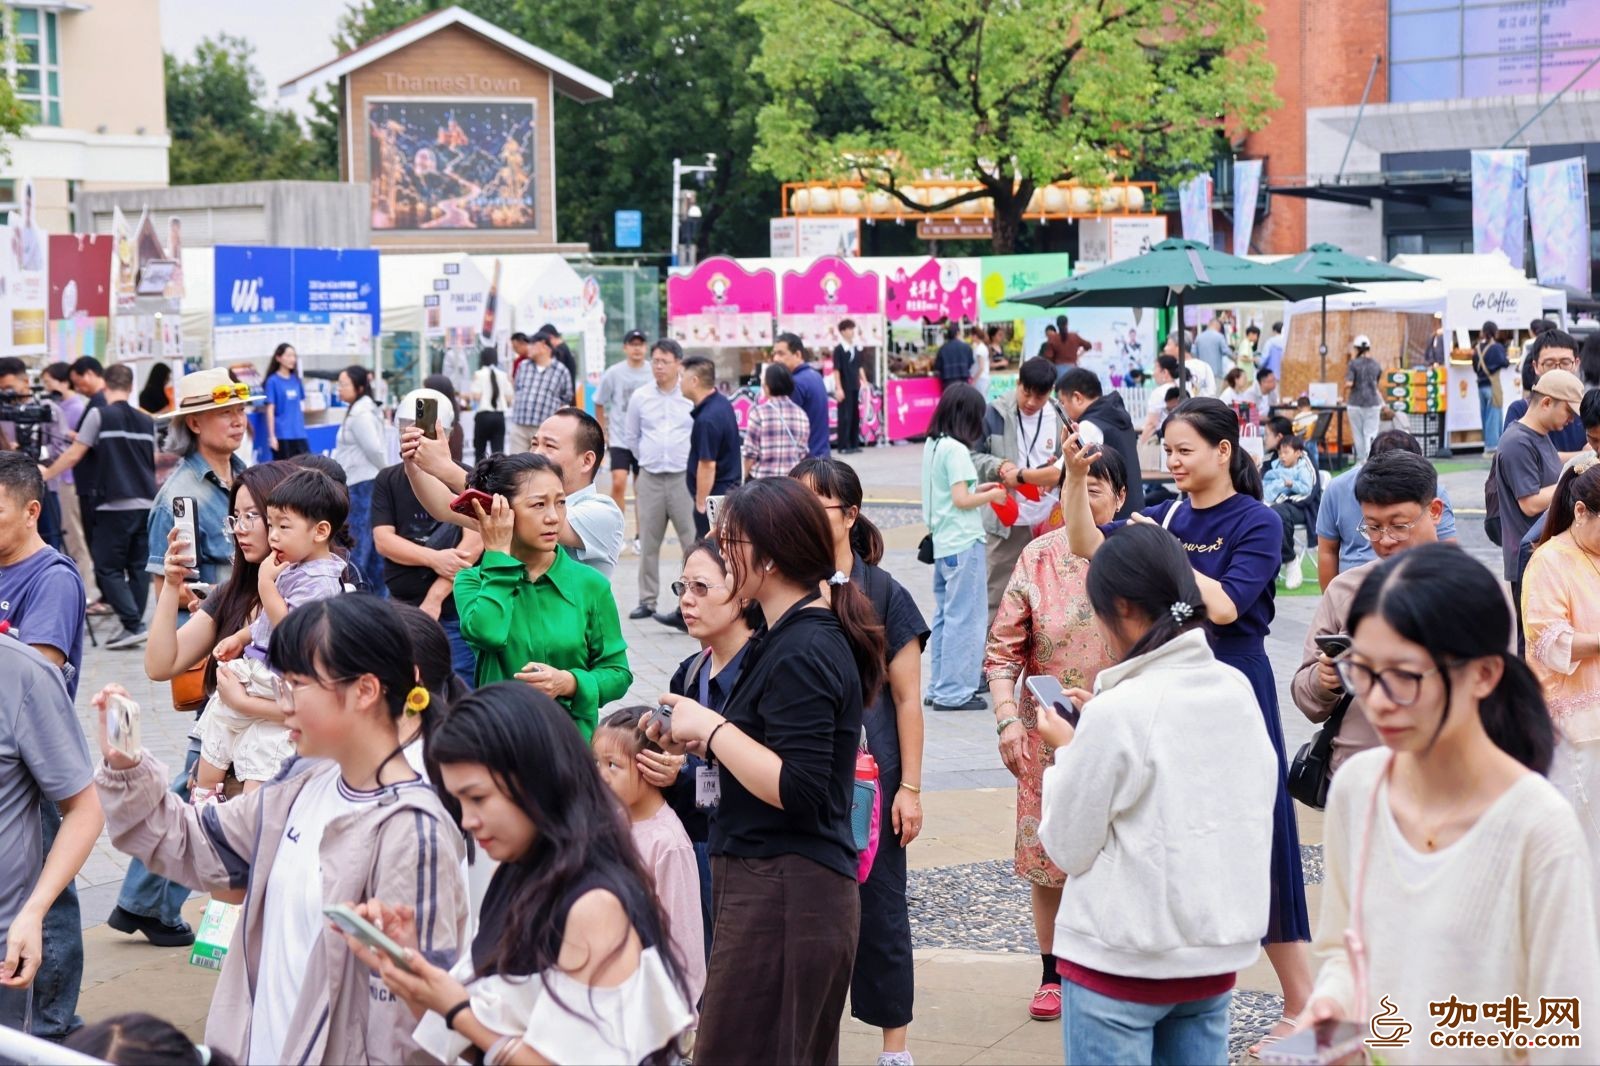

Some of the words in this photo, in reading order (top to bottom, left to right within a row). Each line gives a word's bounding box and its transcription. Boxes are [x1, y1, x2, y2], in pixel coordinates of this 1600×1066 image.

[382, 72, 521, 92] ThamesTown
[1472, 292, 1485, 309] Go
[1487, 291, 1518, 313] Coffee
